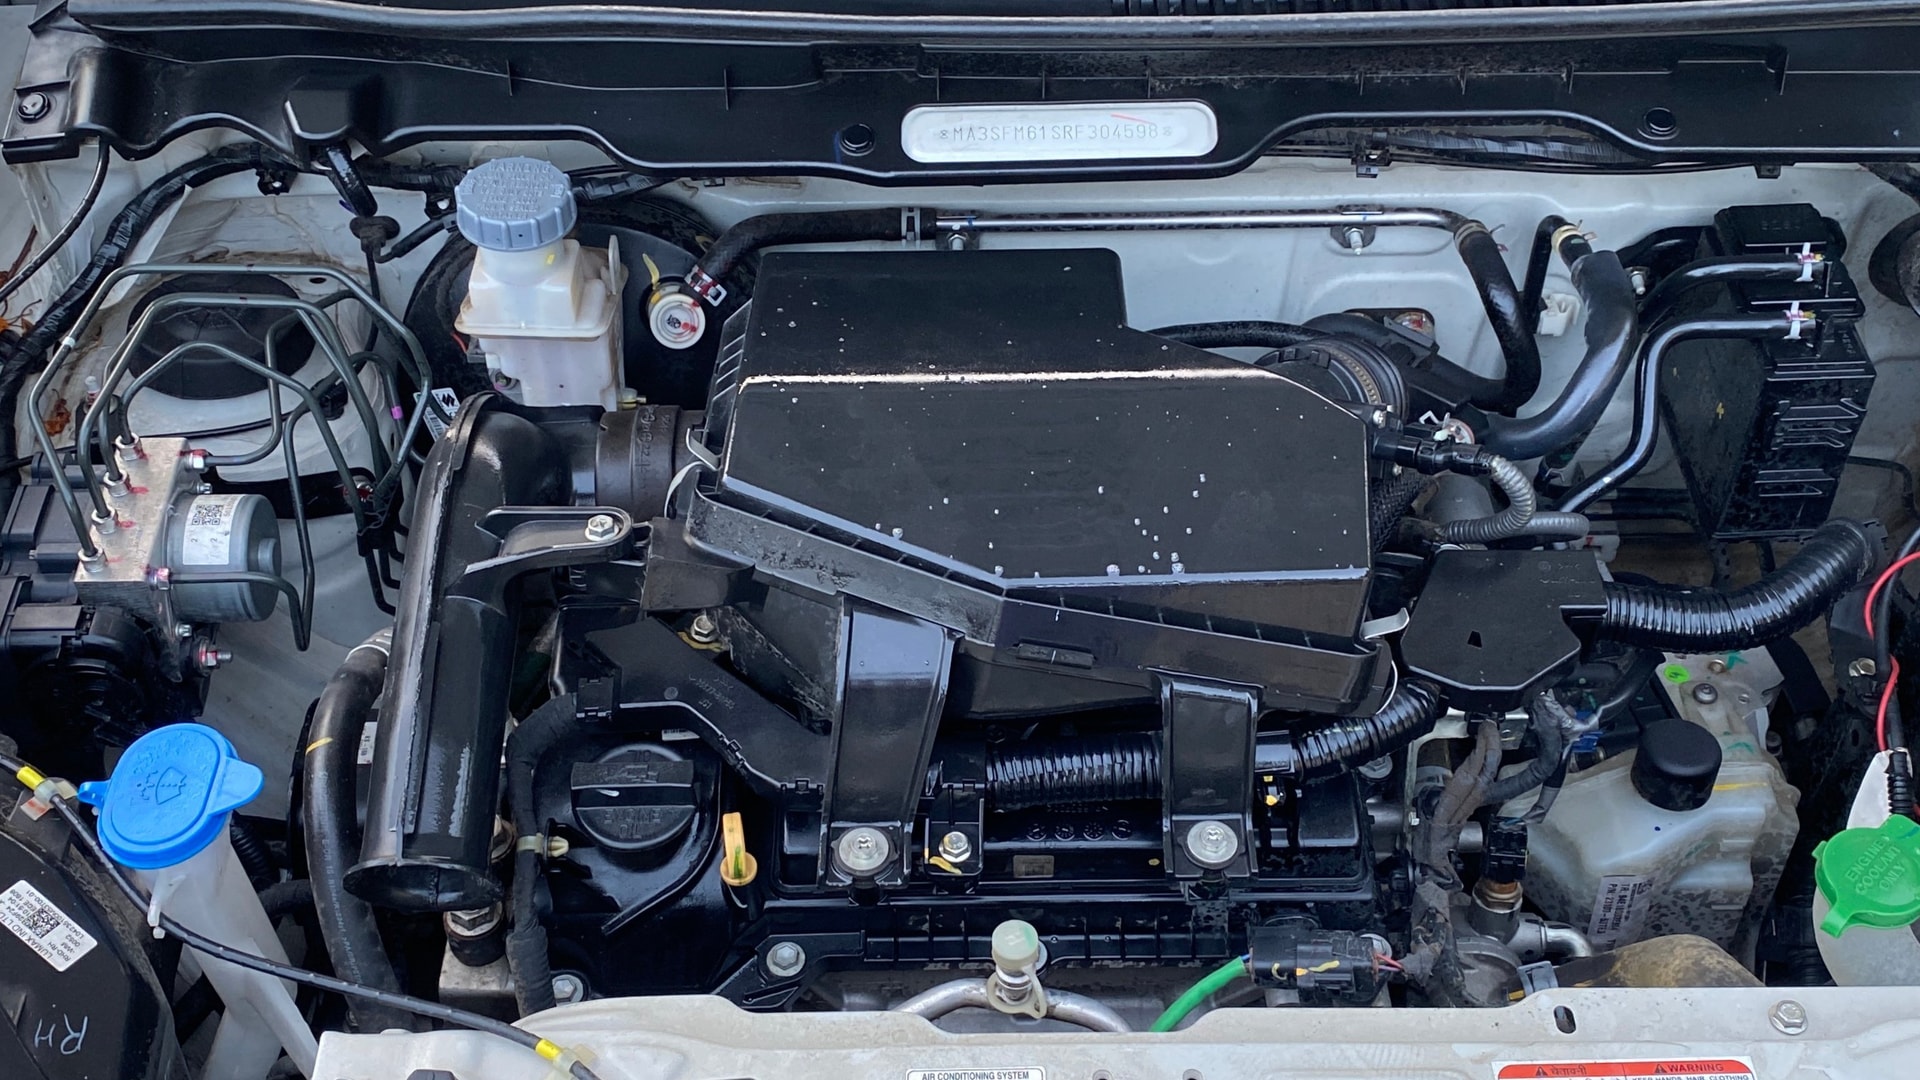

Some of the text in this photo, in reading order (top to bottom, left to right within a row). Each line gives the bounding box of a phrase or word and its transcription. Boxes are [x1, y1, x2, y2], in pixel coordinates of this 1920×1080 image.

[1845, 839, 1886, 882] ENGINE
[1855, 846, 1901, 896] COOLANT
[1879, 864, 1906, 891] ONLY
[12, 924, 28, 938] IND
[24, 934, 53, 959] LUMAX
[47, 941, 72, 962] RHD-RH
[34, 1013, 89, 1055] RH
[921, 1071, 1030, 1080] AIR CONDITIONING SYSTEM
[1668, 1063, 1725, 1073] WARNING
